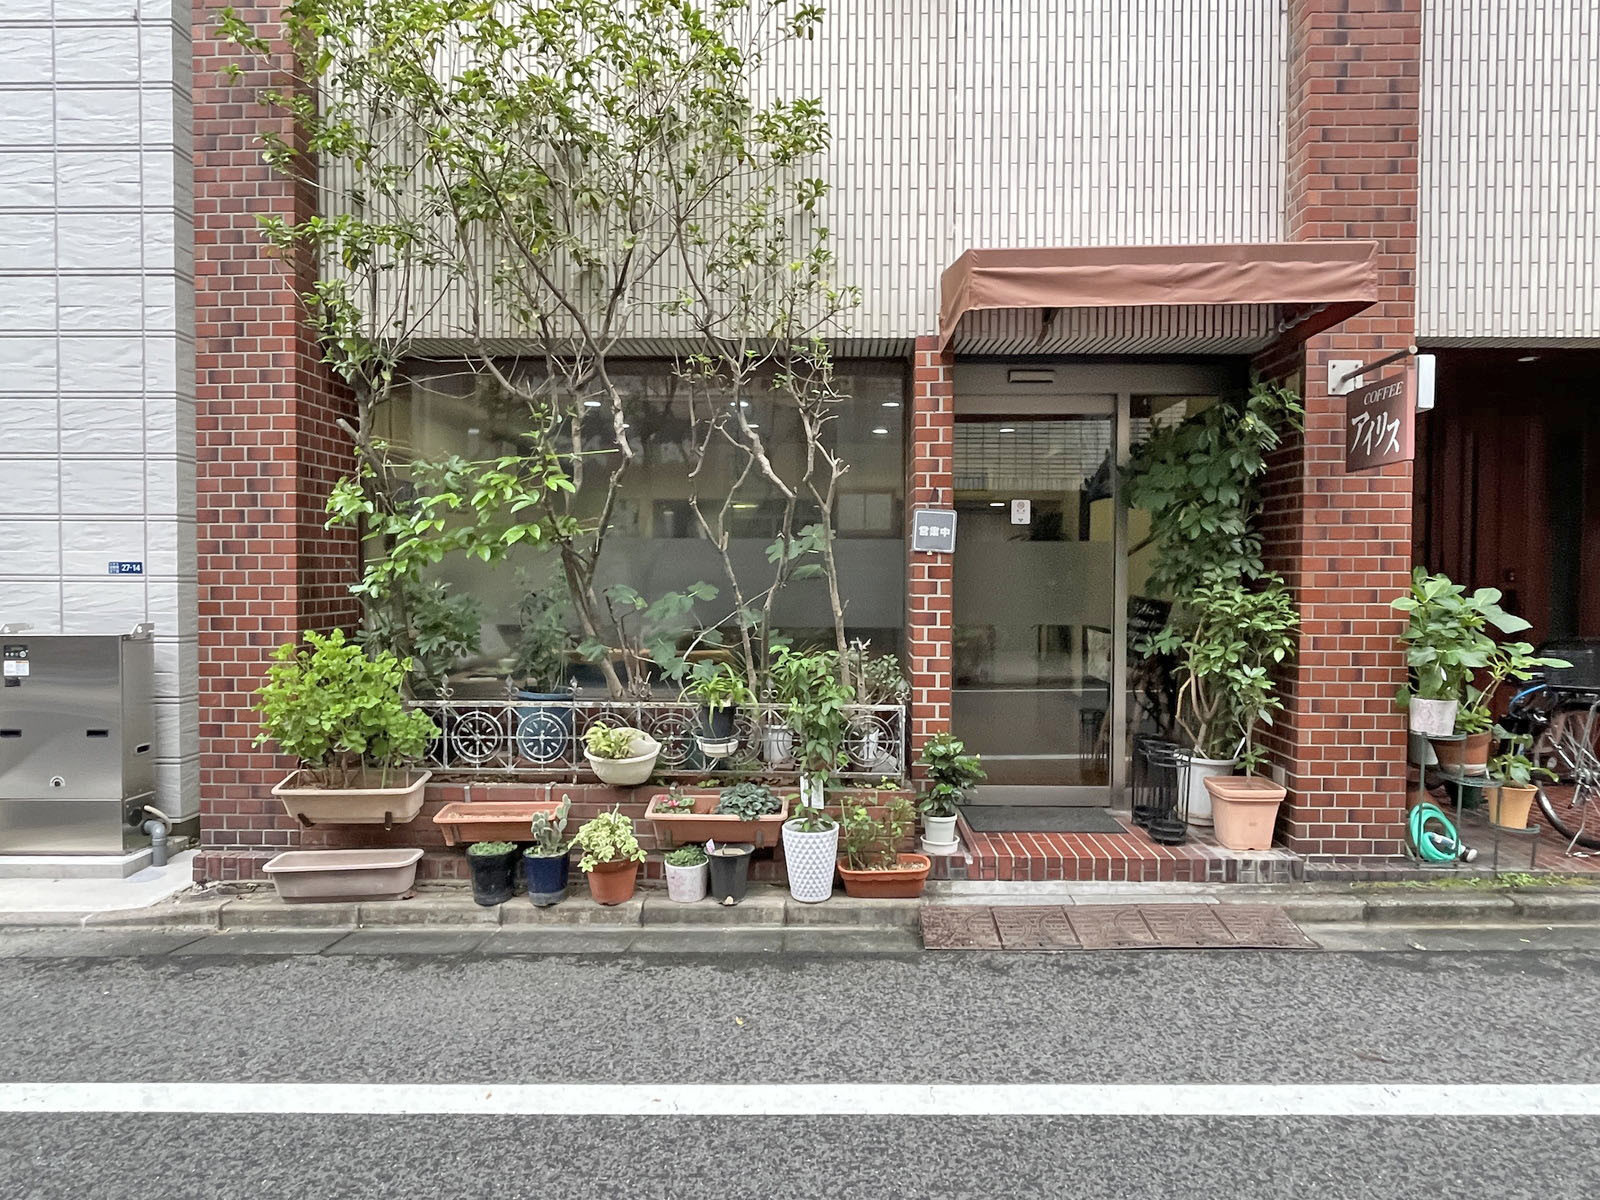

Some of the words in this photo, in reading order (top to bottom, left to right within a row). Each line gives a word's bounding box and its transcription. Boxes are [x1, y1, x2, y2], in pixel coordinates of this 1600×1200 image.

[1364, 381, 1404, 405] COFFEE
[1350, 411, 1400, 456] アイリス
[918, 525, 951, 537] 営業中
[121, 563, 141, 572] 27-14
